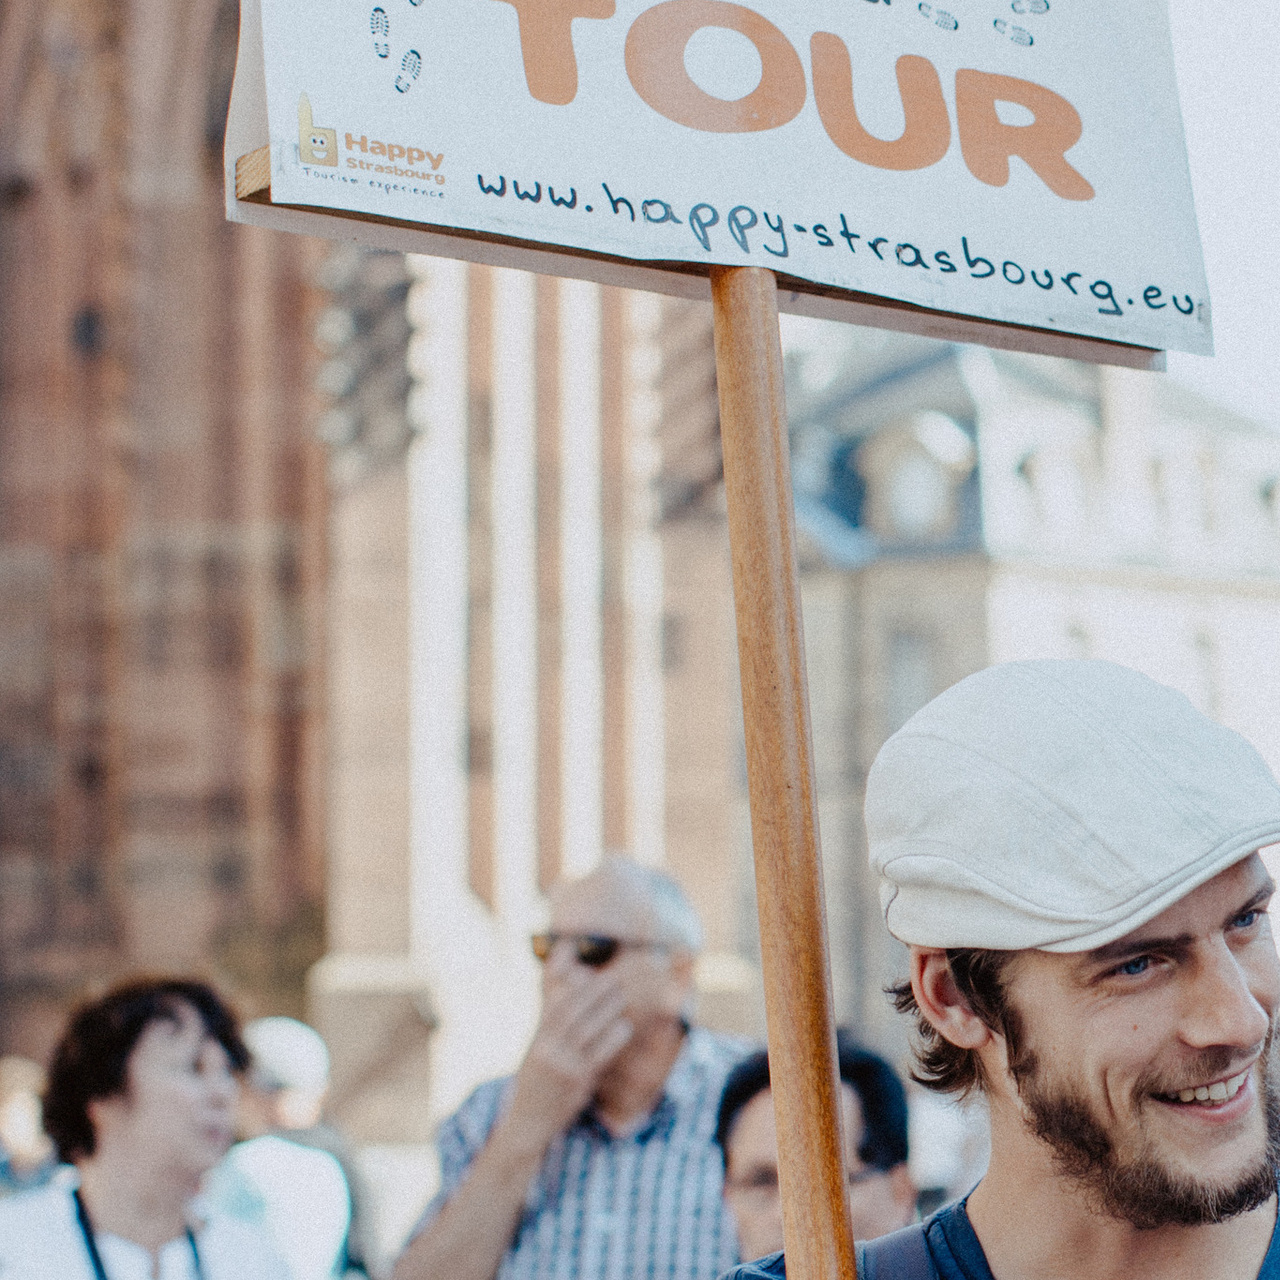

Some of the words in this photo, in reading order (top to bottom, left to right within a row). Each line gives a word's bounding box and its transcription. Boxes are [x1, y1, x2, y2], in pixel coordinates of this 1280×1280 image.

[344, 132, 445, 171] Happy
[346, 157, 446, 186] Strasbourg
[368, 179, 446, 199] experience
[476, 173, 1197, 318] www.happy-strasbourg.eu
